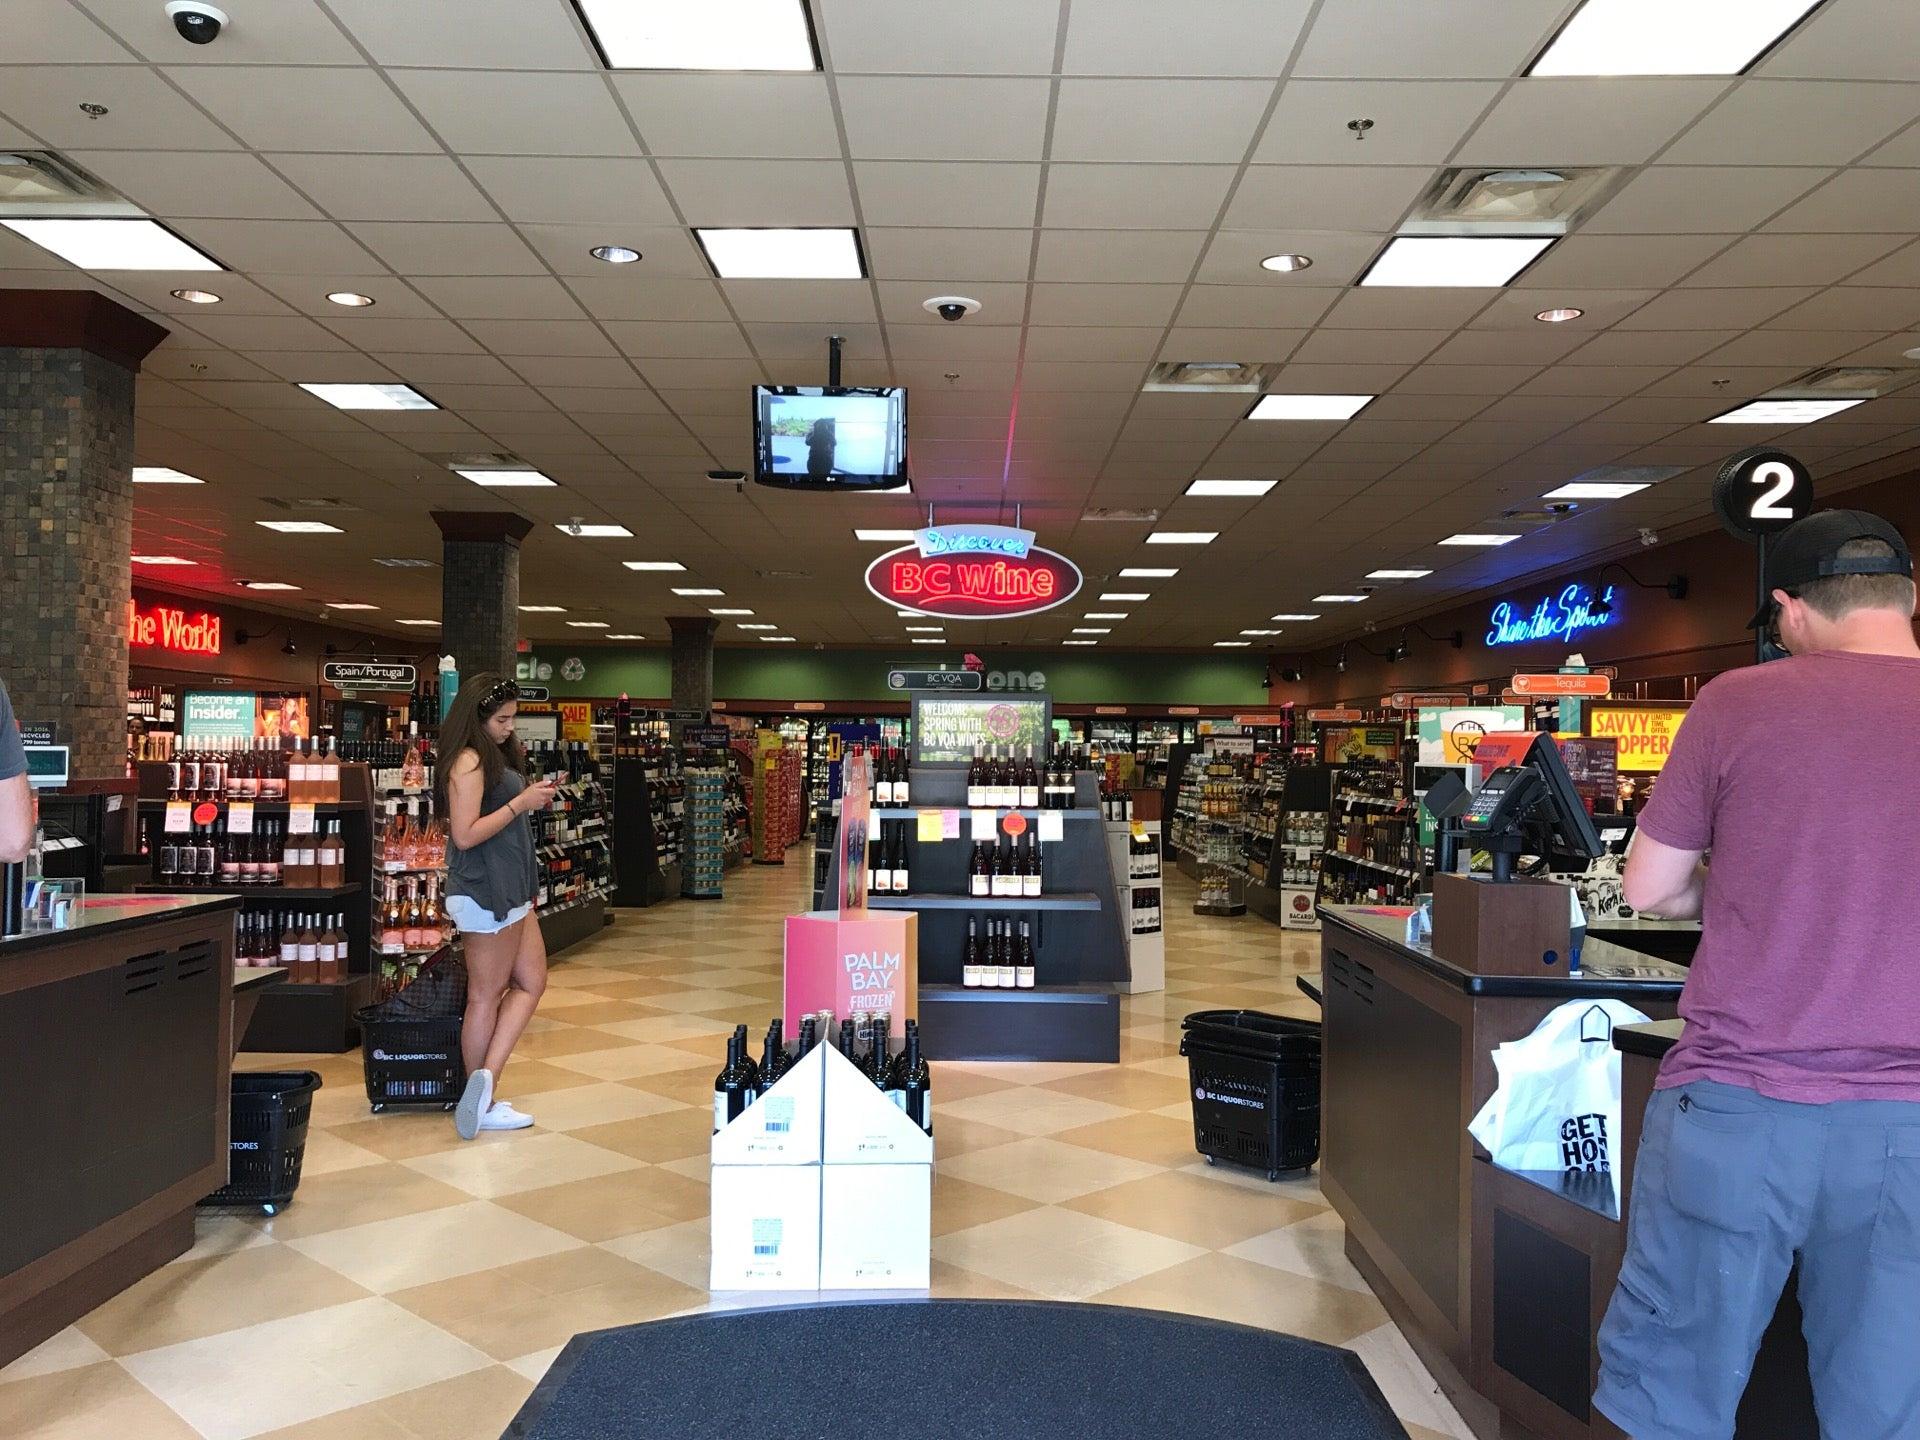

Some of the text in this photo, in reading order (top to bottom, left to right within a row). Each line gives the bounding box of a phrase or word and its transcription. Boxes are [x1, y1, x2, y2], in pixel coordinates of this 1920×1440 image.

[1750, 461, 1795, 519] 2
[927, 530, 1026, 555] Discover
[892, 561, 1054, 597] BC Wine
[128, 598, 220, 654] he World
[1486, 602, 1528, 646] Share
[1527, 597, 1551, 640] the
[335, 665, 405, 680] Spain/Portugal
[516, 656, 553, 680] cle
[927, 674, 962, 684] BC VQA
[986, 670, 1046, 691] one
[1554, 676, 1586, 690] Tequila
[189, 694, 250, 705] Become an
[924, 703, 968, 716] WELCOME
[1651, 713, 1672, 721] LIMITED
[924, 718, 982, 732] SPRING WITH
[1460, 723, 1485, 731] THE
[1596, 713, 1649, 733] SAVVY
[923, 733, 987, 749] BC VQA WINES
[1600, 735, 1670, 755] OPPER
[1470, 852, 1491, 870] Organic
[844, 951, 900, 972] PALM
[851, 971, 893, 991] BAY
[850, 993, 893, 1009] FROZEN
[1206, 1092, 1265, 1110] BC LIQUORSTORES
[1561, 1113, 1608, 1141] GET
